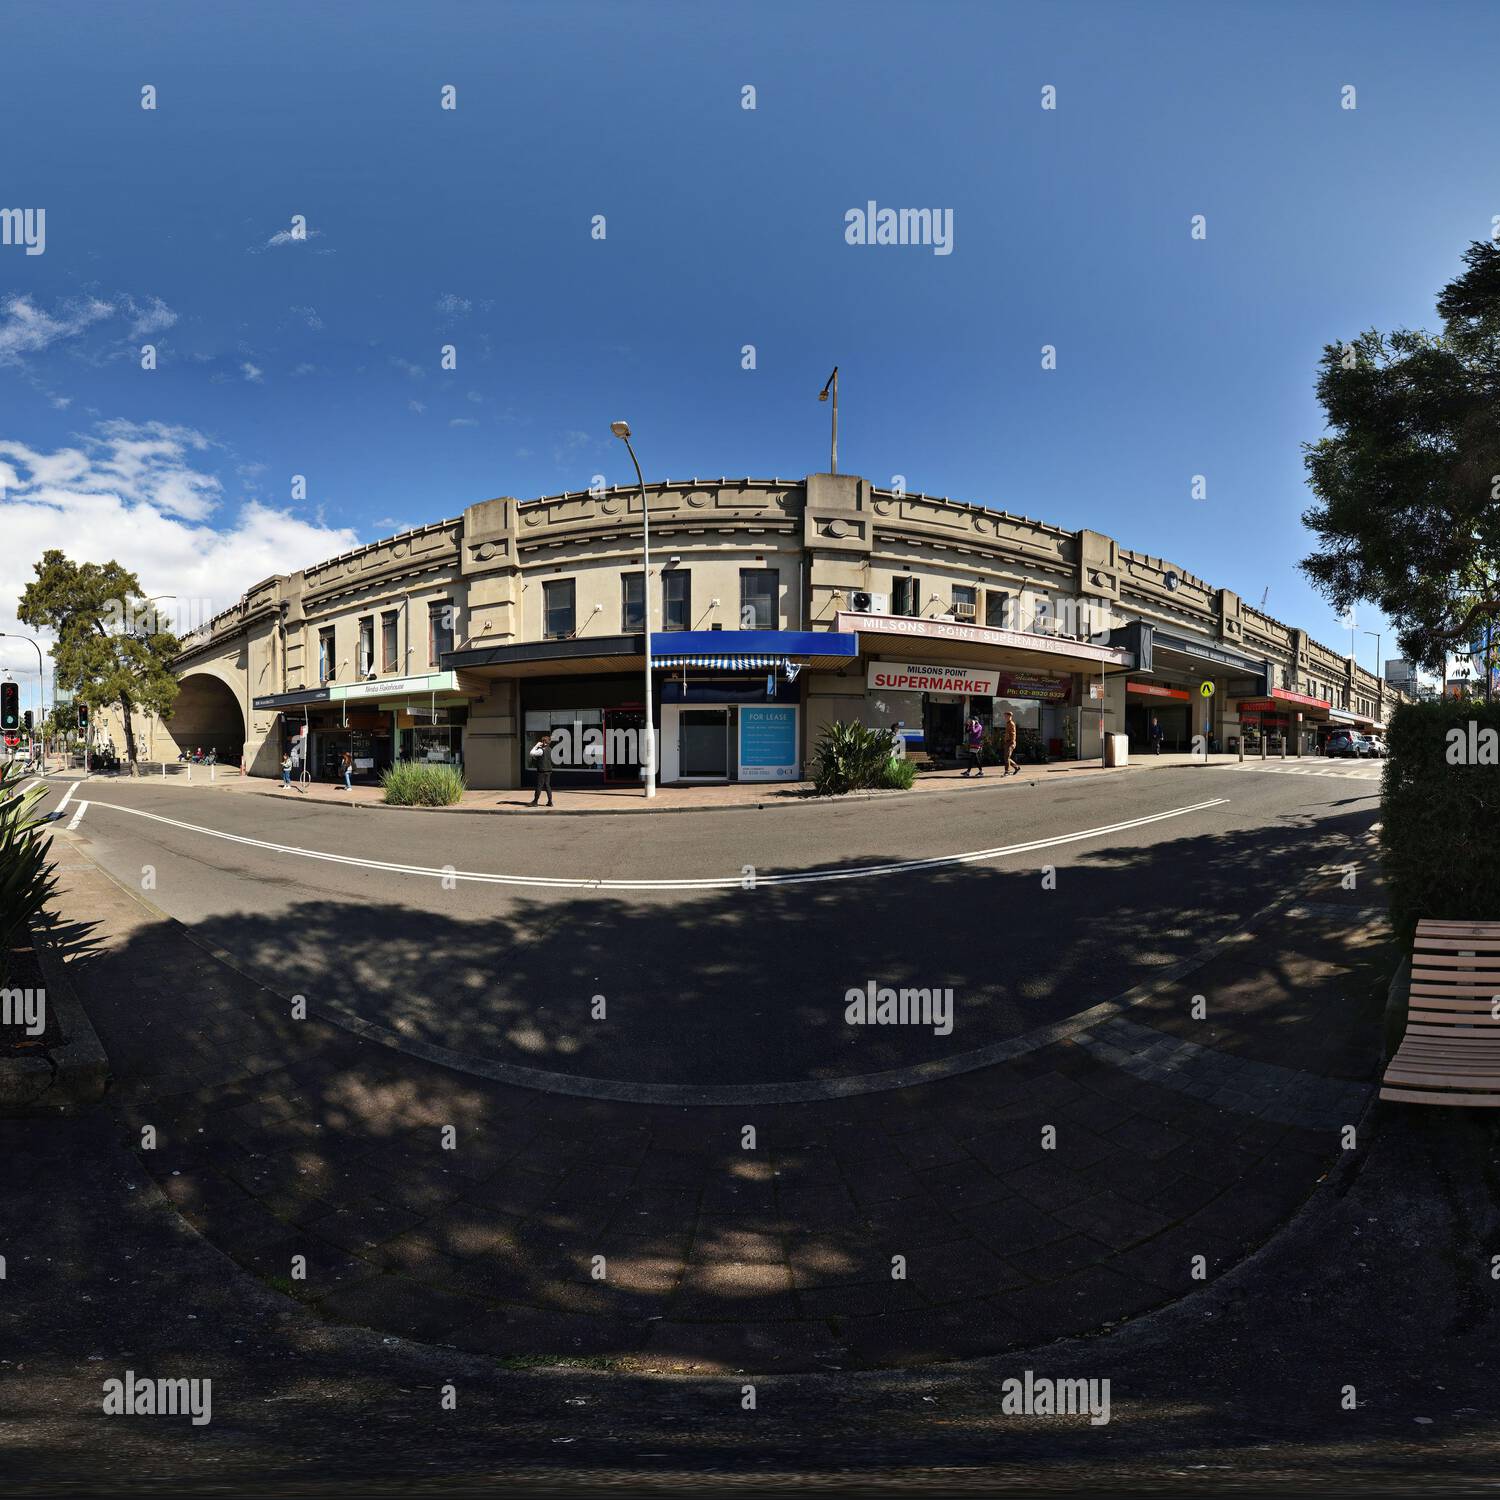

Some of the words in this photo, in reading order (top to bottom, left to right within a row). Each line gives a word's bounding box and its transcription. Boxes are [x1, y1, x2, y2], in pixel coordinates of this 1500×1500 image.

[863, 618, 925, 633] MILSONS
[938, 625, 975, 639] POINT
[983, 631, 1065, 652] SUPERMARKET
[907, 666, 943, 675] MILSONS
[945, 669, 967, 677] POINT
[874, 674, 991, 693] SUPERMARKET
[749, 712, 764, 721] FOR
[766, 712, 788, 721] LEASE
